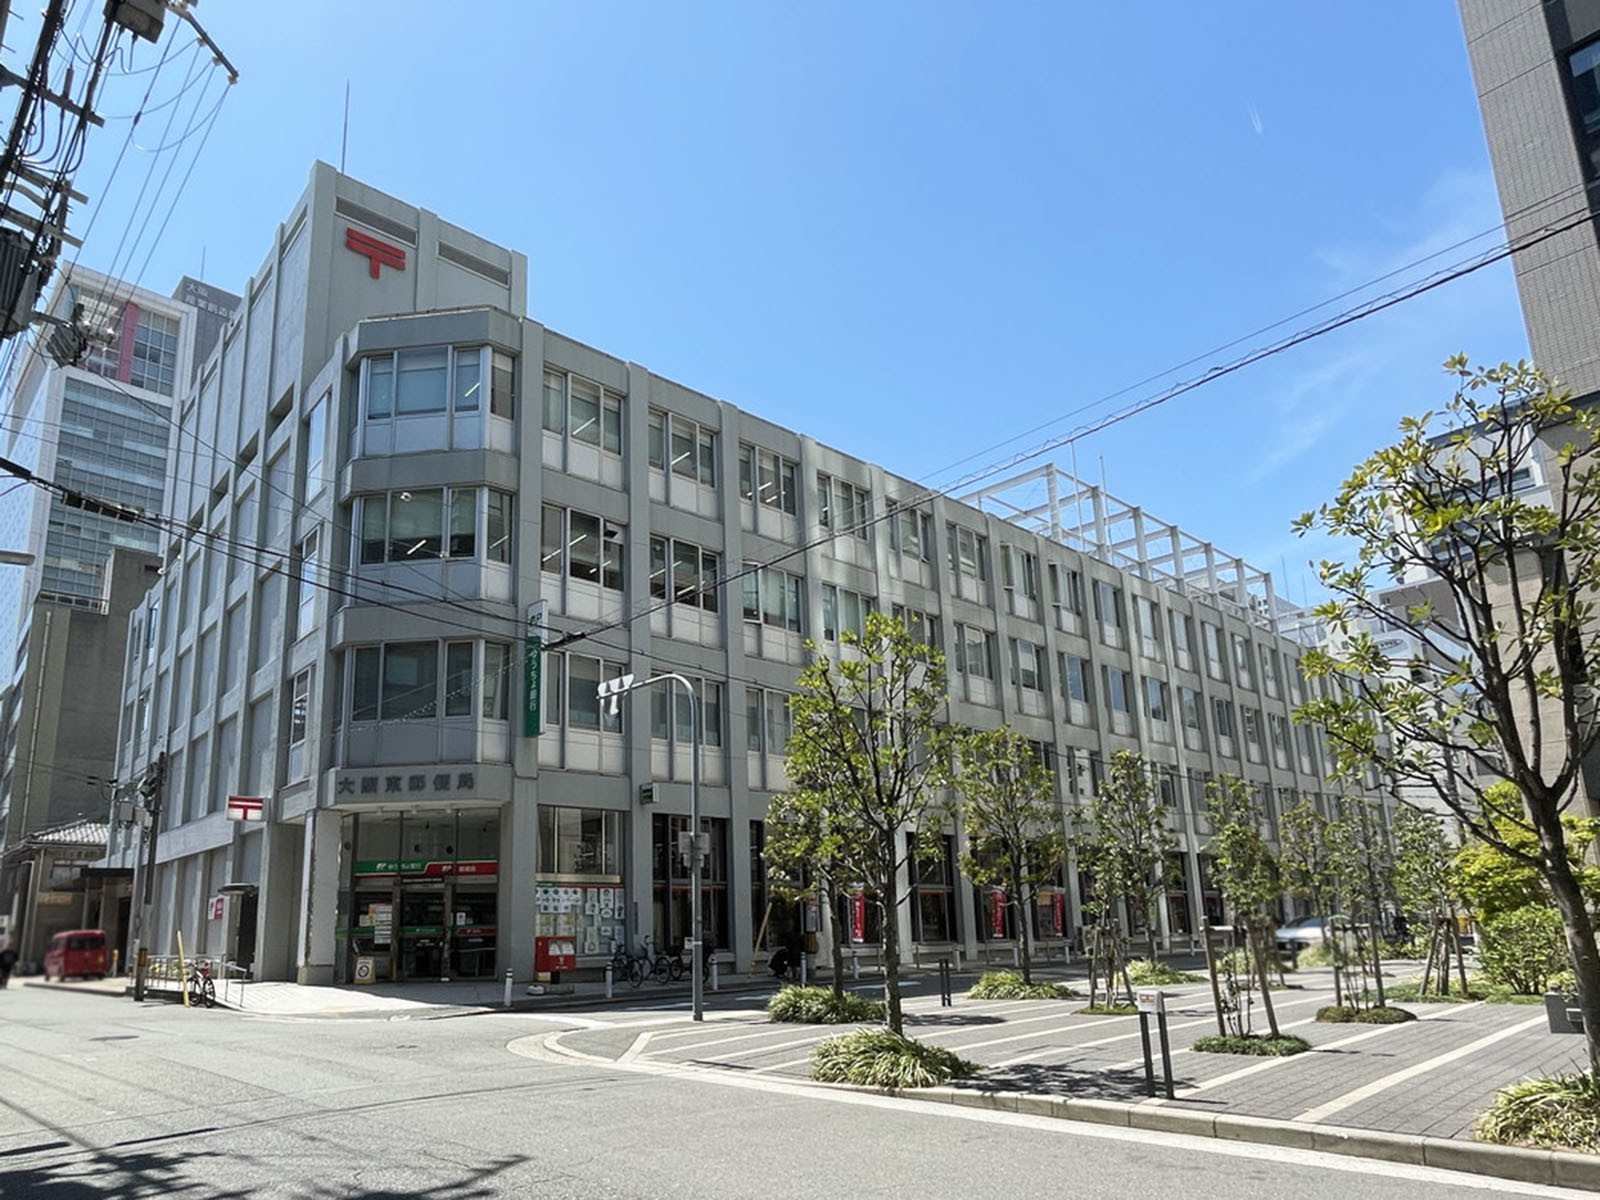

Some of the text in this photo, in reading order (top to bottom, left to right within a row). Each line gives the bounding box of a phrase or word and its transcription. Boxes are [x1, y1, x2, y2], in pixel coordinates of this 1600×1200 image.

[338, 773, 474, 795] 大阪東郵便局
